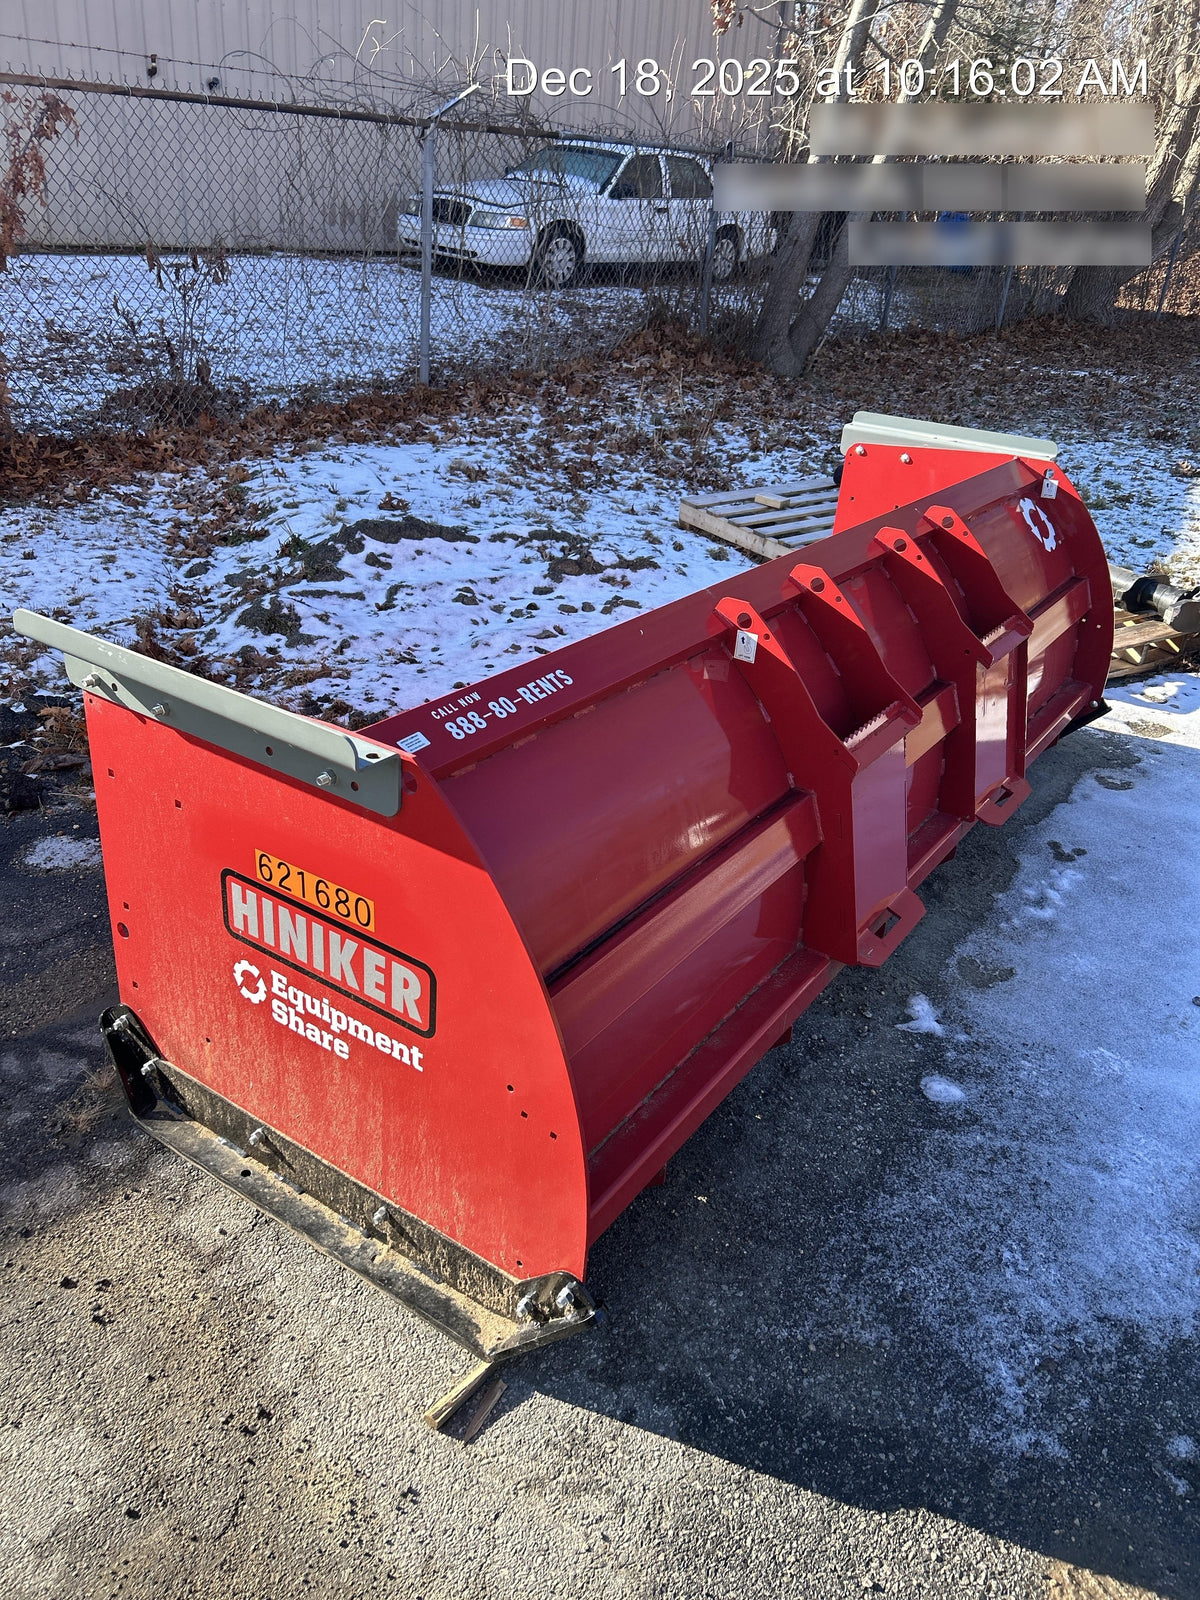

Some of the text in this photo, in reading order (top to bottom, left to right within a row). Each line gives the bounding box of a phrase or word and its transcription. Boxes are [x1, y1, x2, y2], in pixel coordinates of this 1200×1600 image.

[430, 691, 482, 720] CALL NOW
[444, 669, 574, 740] 888-80-RENTS
[258, 853, 372, 928] 621680
[231, 881, 423, 1024] HINIKER
[270, 969, 424, 1073] Equipment
[271, 999, 350, 1060] Share
